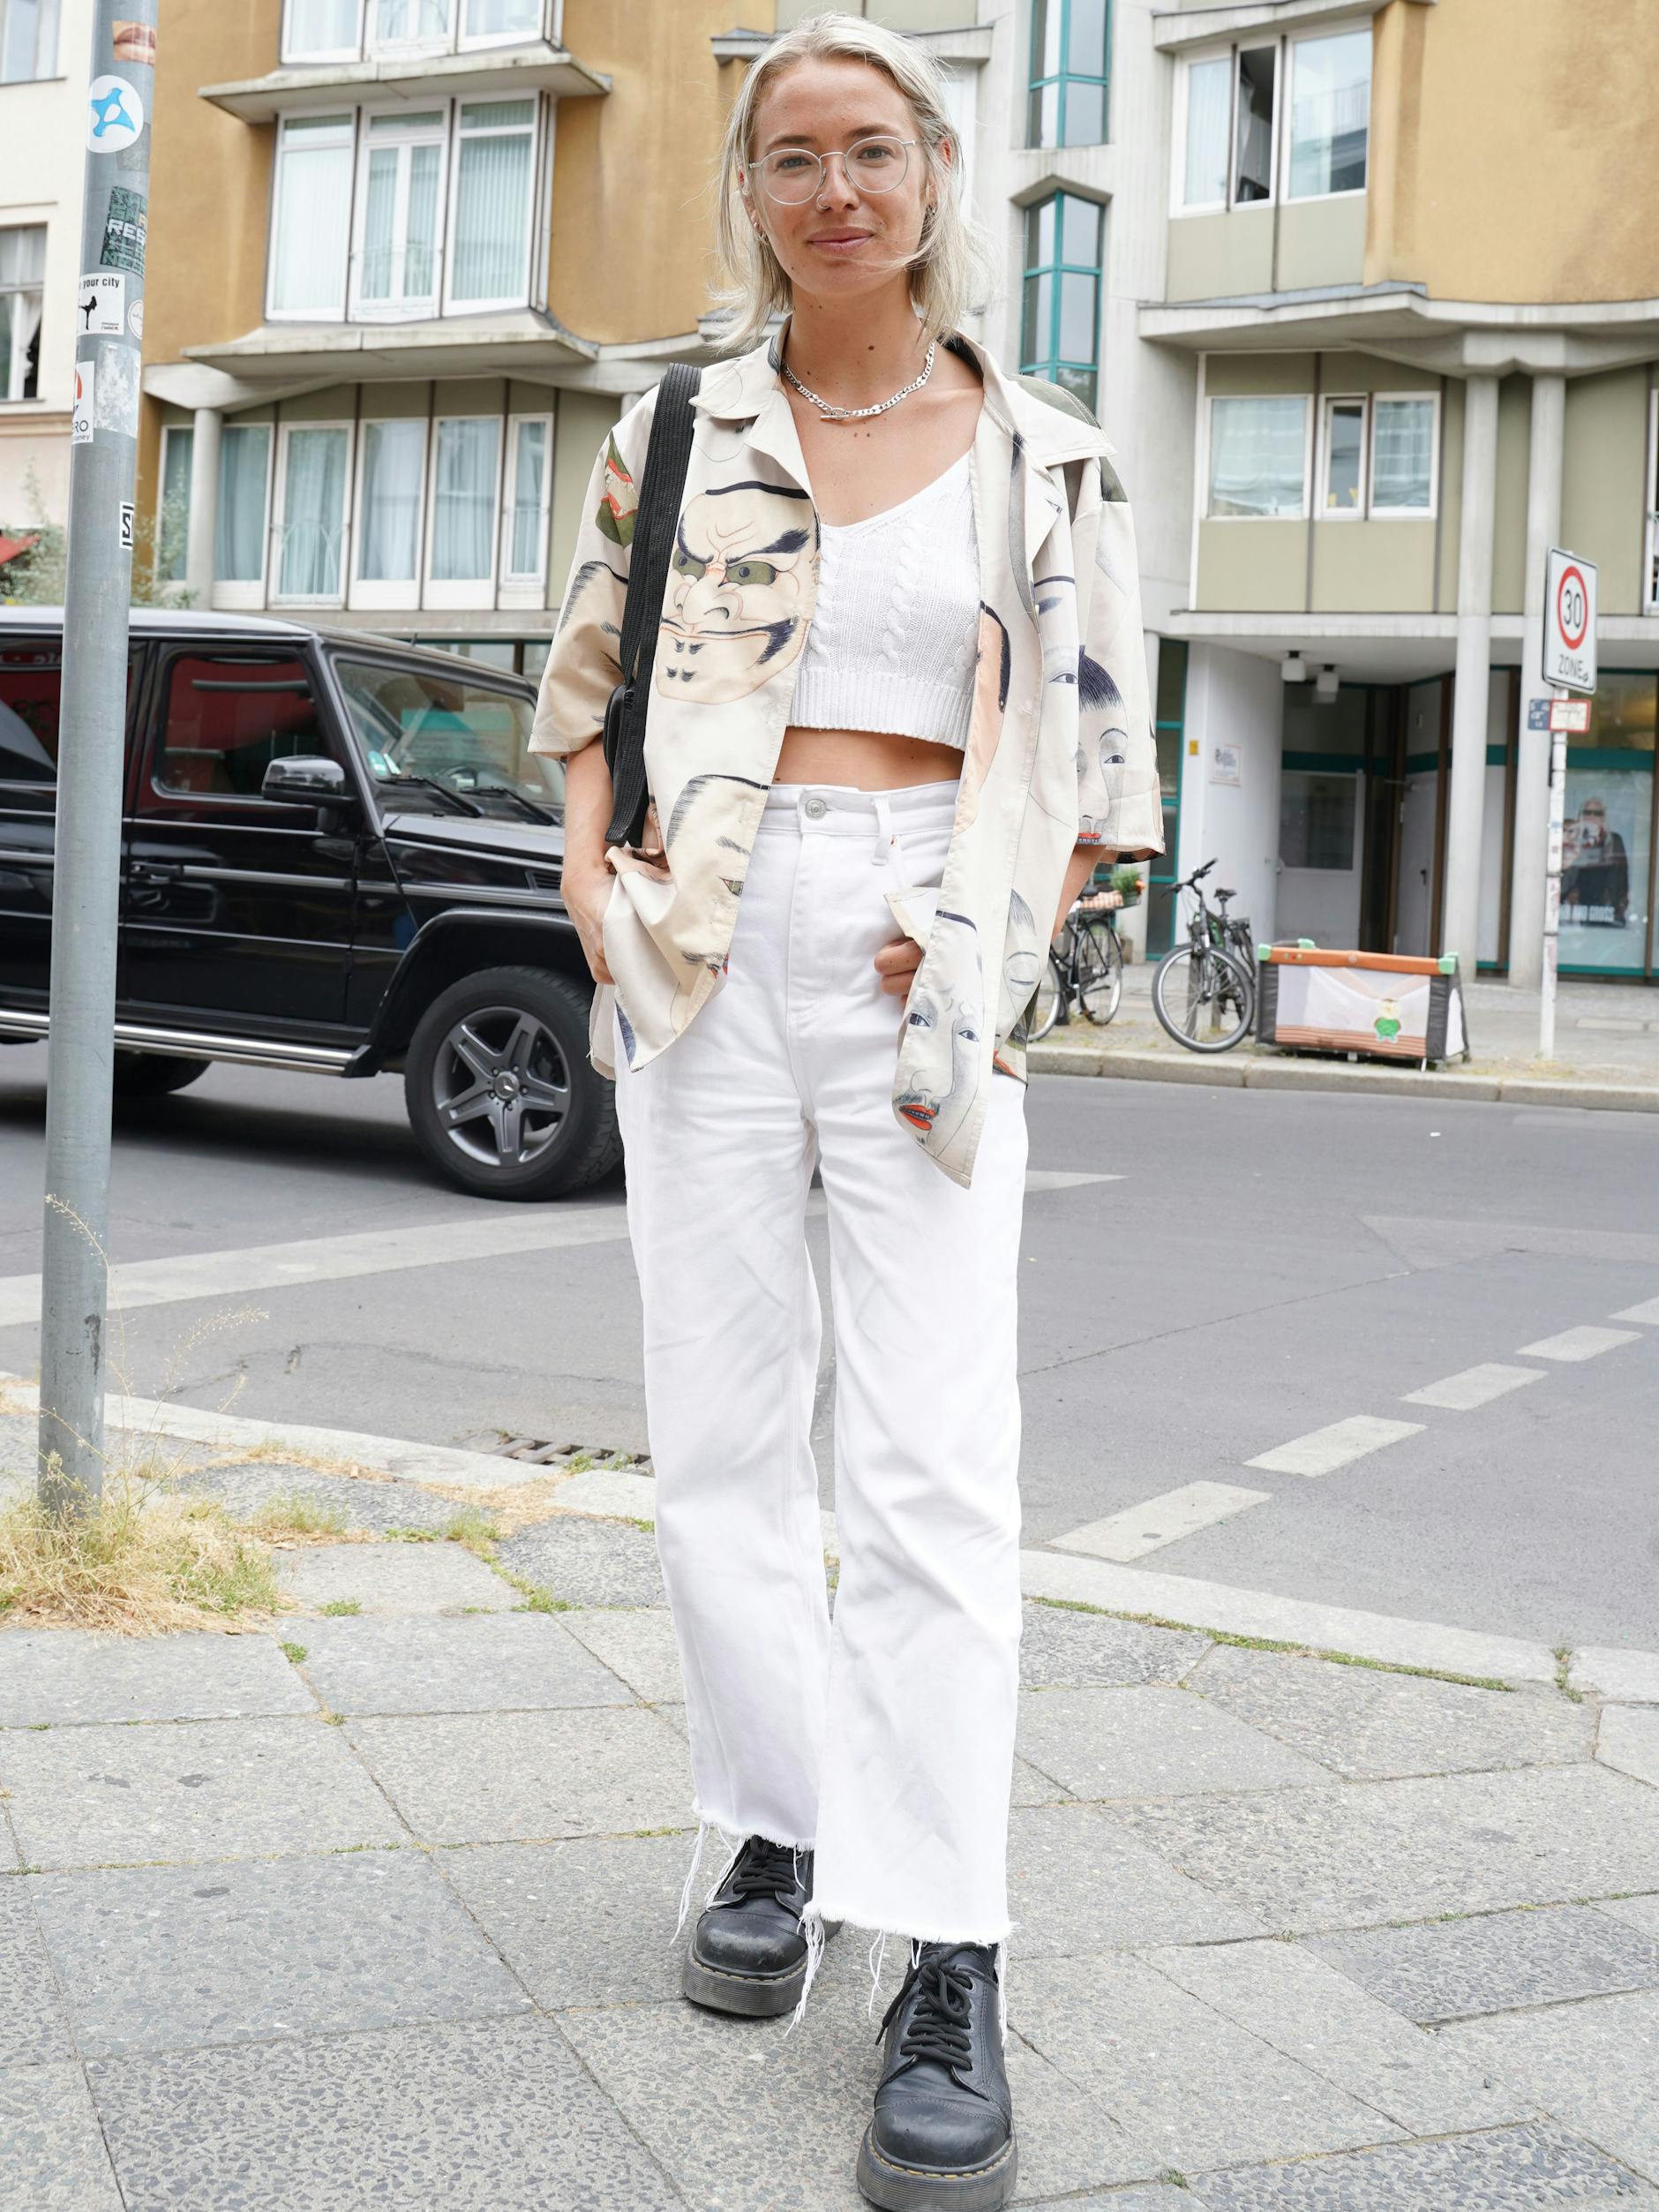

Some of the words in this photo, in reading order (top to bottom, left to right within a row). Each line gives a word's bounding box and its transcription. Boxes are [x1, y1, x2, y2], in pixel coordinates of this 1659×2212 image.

[101, 277, 120, 289] city
[1564, 589, 1582, 628] 30
[1558, 654, 1584, 680] ZONE
